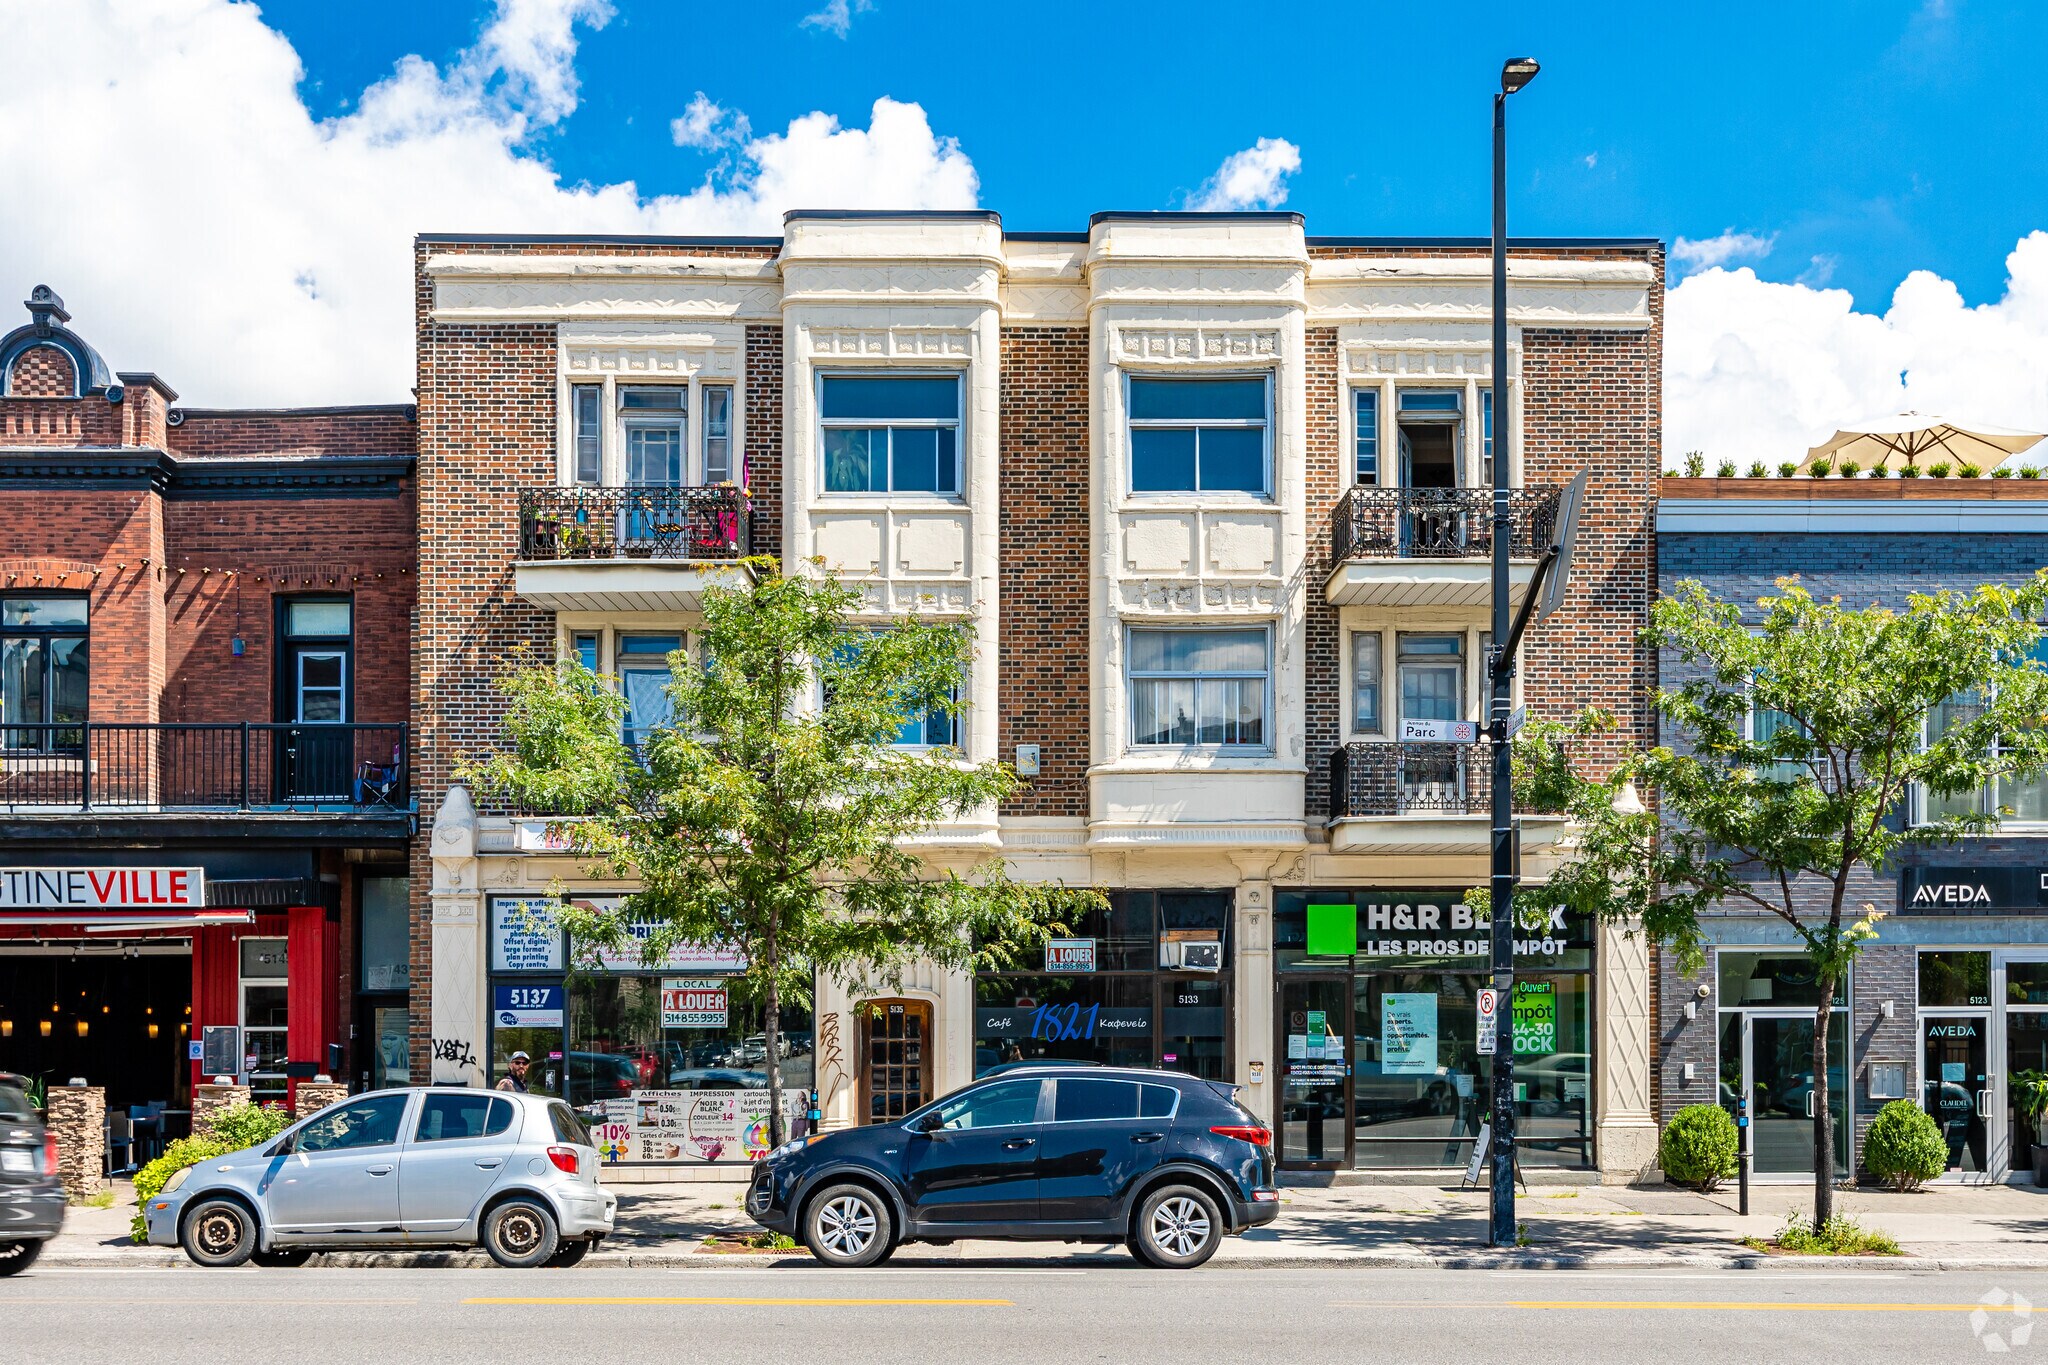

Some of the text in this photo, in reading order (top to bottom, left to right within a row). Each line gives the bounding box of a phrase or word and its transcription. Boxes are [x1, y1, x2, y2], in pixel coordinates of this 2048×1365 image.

[1406, 726, 1436, 737] Parc
[0, 870, 188, 904] TINEVILLE
[1912, 884, 1991, 902] AVEDA
[1368, 904, 1568, 930] H&R BLCK
[503, 946, 521, 954] large
[1367, 936, 1567, 956] LES PROS DE MPÔT
[264, 954, 288, 964] 514
[522, 953, 549, 961] printing
[1059, 949, 1093, 962] LOUER
[676, 980, 712, 988] LOCAL
[1520, 981, 1551, 993] Ouvert
[510, 989, 551, 1004] 5137
[678, 993, 725, 1010] LOUER
[1178, 995, 1199, 1004] 5133
[1969, 996, 1988, 1004] 5123
[889, 1005, 904, 1014] 5135
[987, 1017, 1012, 1028] Café
[1028, 1002, 1100, 1042] 1821
[1929, 1025, 1977, 1036] AVEDA
[1512, 1036, 1554, 1052] OCK
[1939, 1099, 1968, 1107] CLAUDEL
[596, 1124, 631, 1141] -10%
